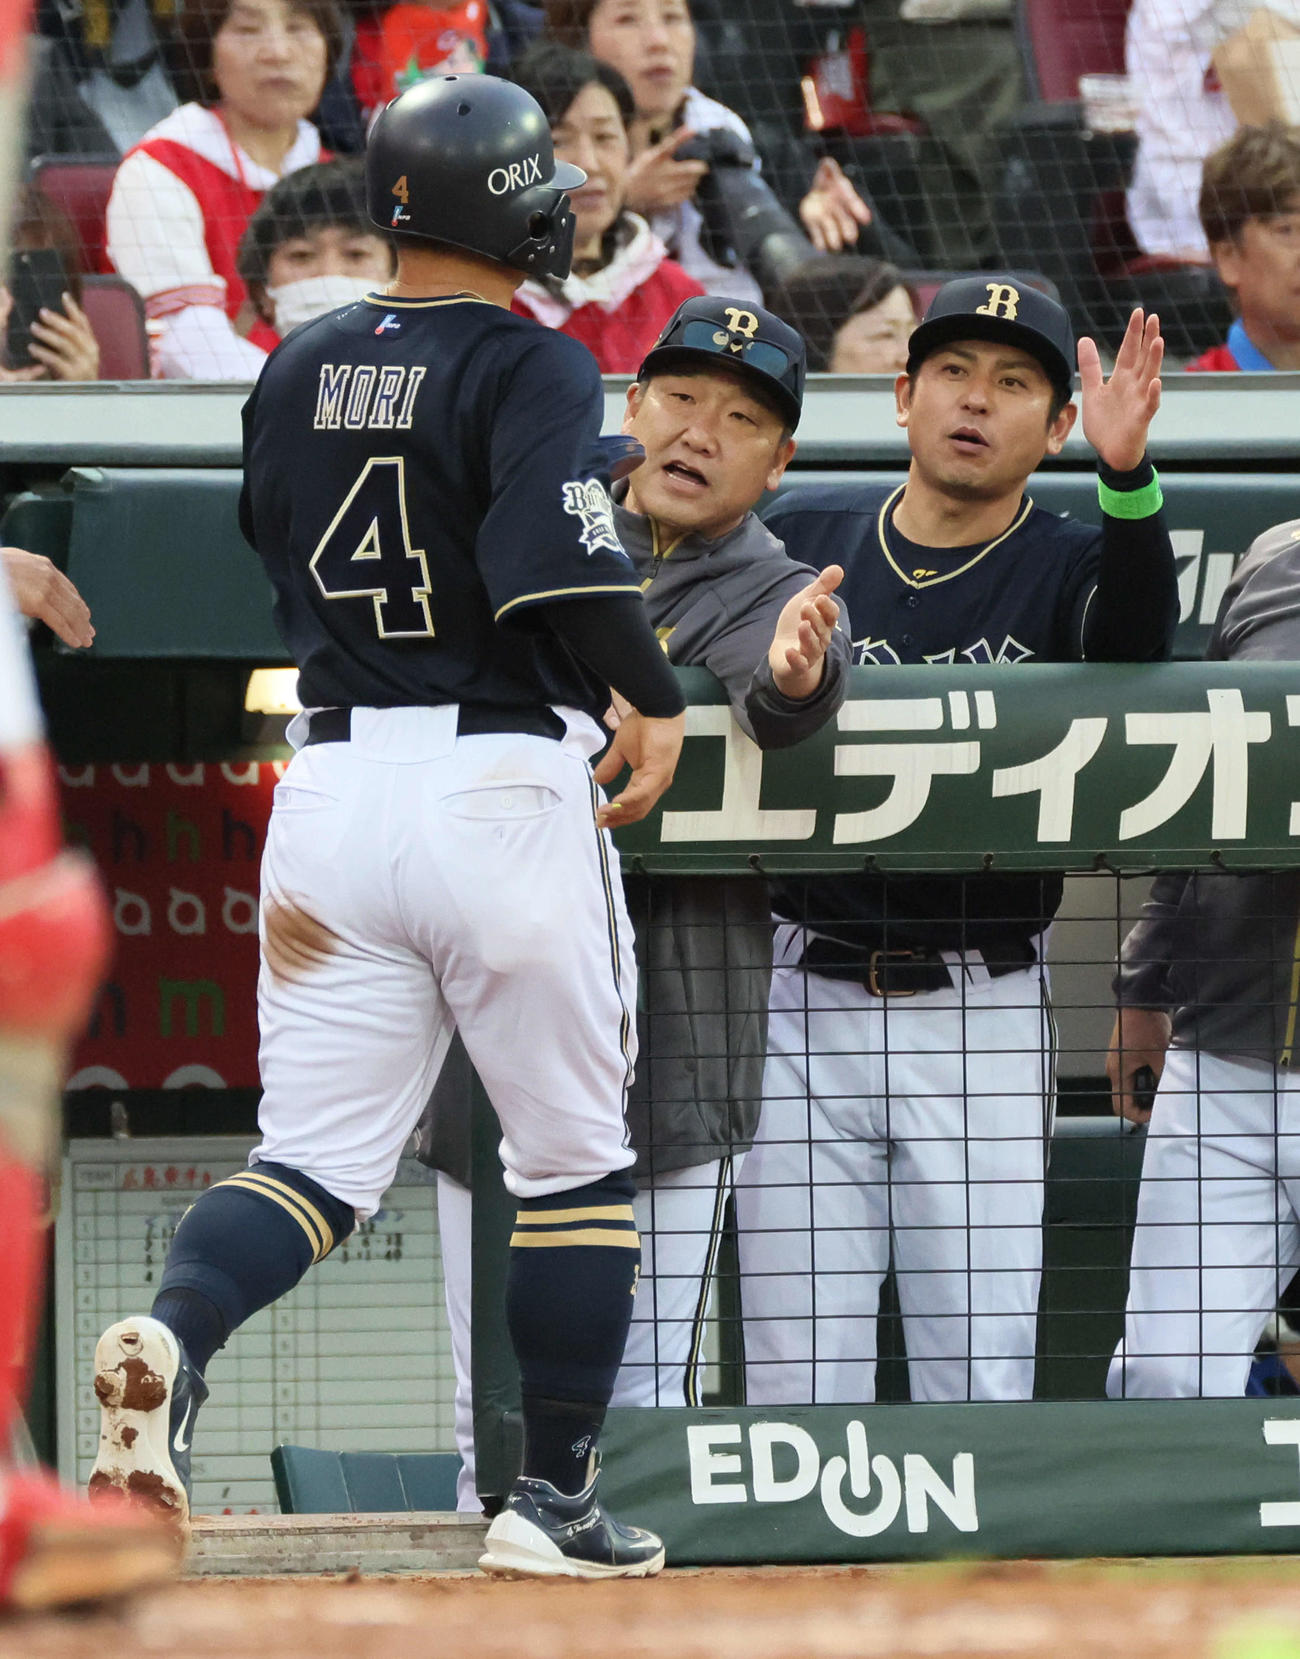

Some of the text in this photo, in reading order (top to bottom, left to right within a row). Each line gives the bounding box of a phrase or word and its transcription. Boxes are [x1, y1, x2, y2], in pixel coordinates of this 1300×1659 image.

[391, 175, 409, 204] 4
[487, 153, 543, 195] ORIX
[313, 364, 427, 430] MORI
[308, 456, 436, 639] 4
[660, 688, 1300, 845] エディオ
[571, 1435, 592, 1458] 4
